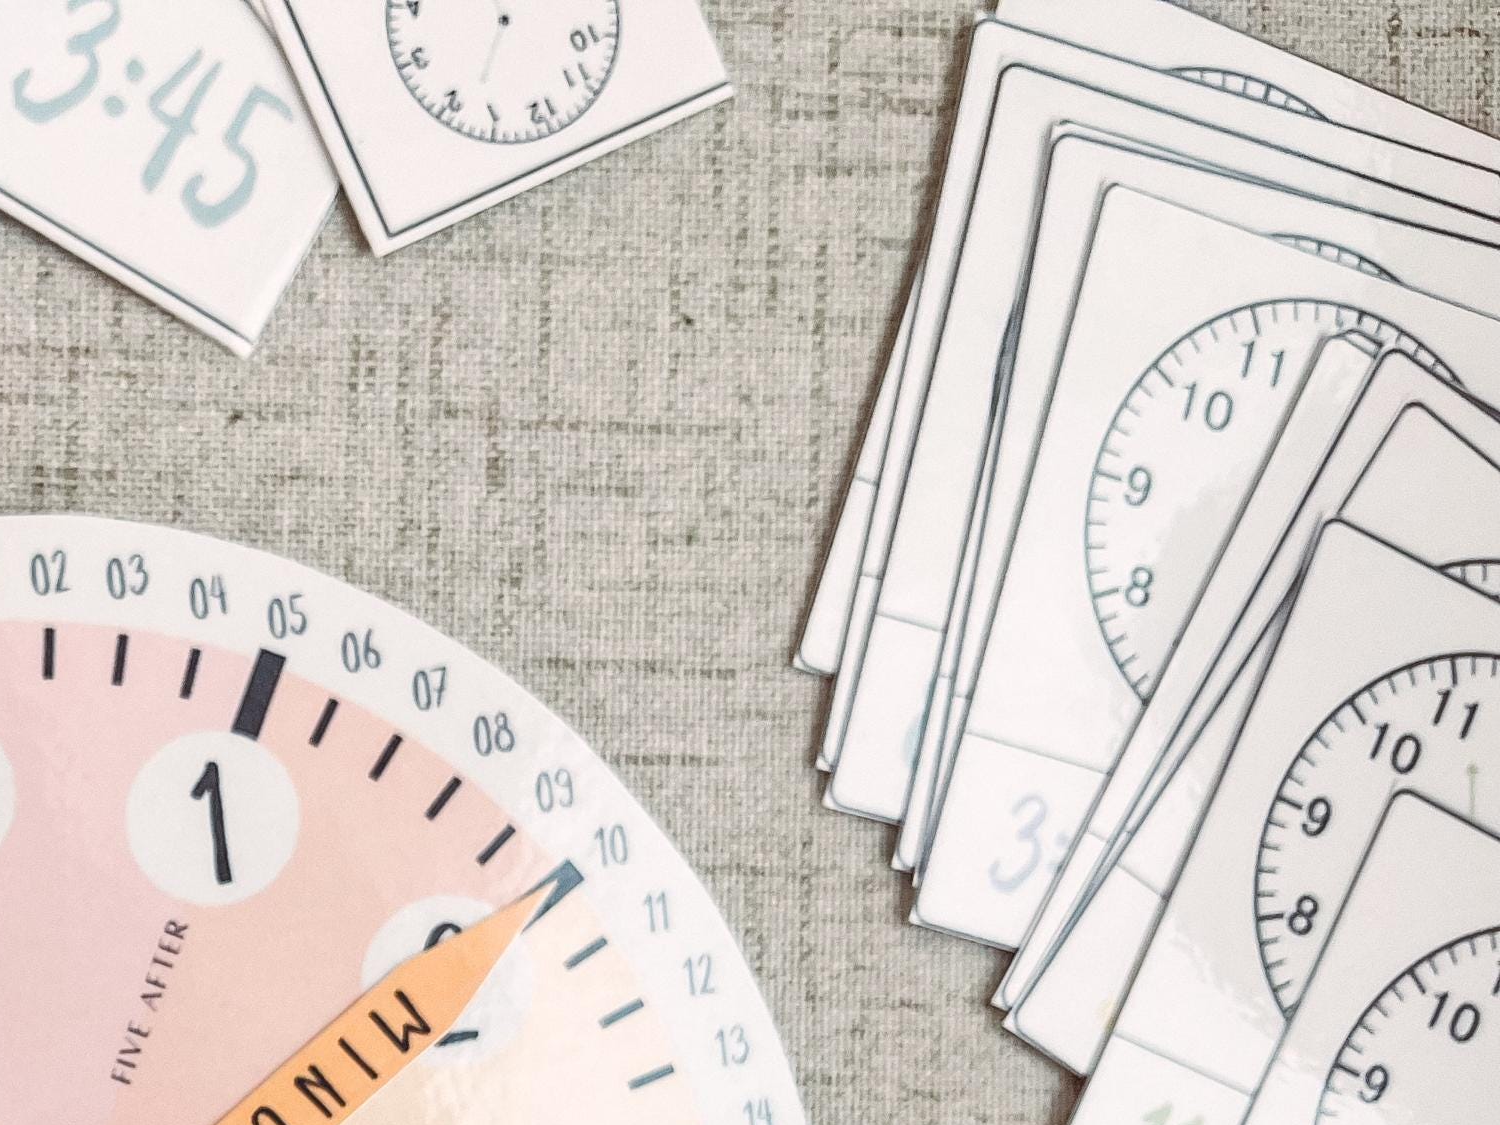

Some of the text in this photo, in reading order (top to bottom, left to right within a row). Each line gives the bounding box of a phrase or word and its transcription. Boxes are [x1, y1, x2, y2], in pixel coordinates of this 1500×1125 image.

[12, 0, 294, 228] 3:45
[1241, 340, 1284, 388] 11
[1181, 382, 1233, 431] 10
[1123, 466, 1152, 506] 9
[29, 549, 71, 596] 02
[106, 553, 150, 600] 03
[1125, 566, 1153, 607] 8
[189, 574, 228, 620] 04
[267, 593, 308, 640] 05
[341, 628, 382, 673] 06
[412, 665, 447, 711] 07
[473, 710, 516, 757] 08
[1433, 689, 1479, 740] 11
[1369, 722, 1422, 775] 10
[535, 767, 575, 814] 09
[190, 761, 233, 885] 1
[1301, 796, 1332, 837] 9
[593, 824, 629, 868] 10
[643, 891, 670, 933] 11
[1288, 895, 1318, 935] 8
[683, 952, 715, 996] 12
[110, 919, 189, 1085] FIVE AFTER
[1428, 990, 1481, 1043] 10
[715, 1024, 750, 1067] 13
[1359, 1063, 1389, 1103] 9
